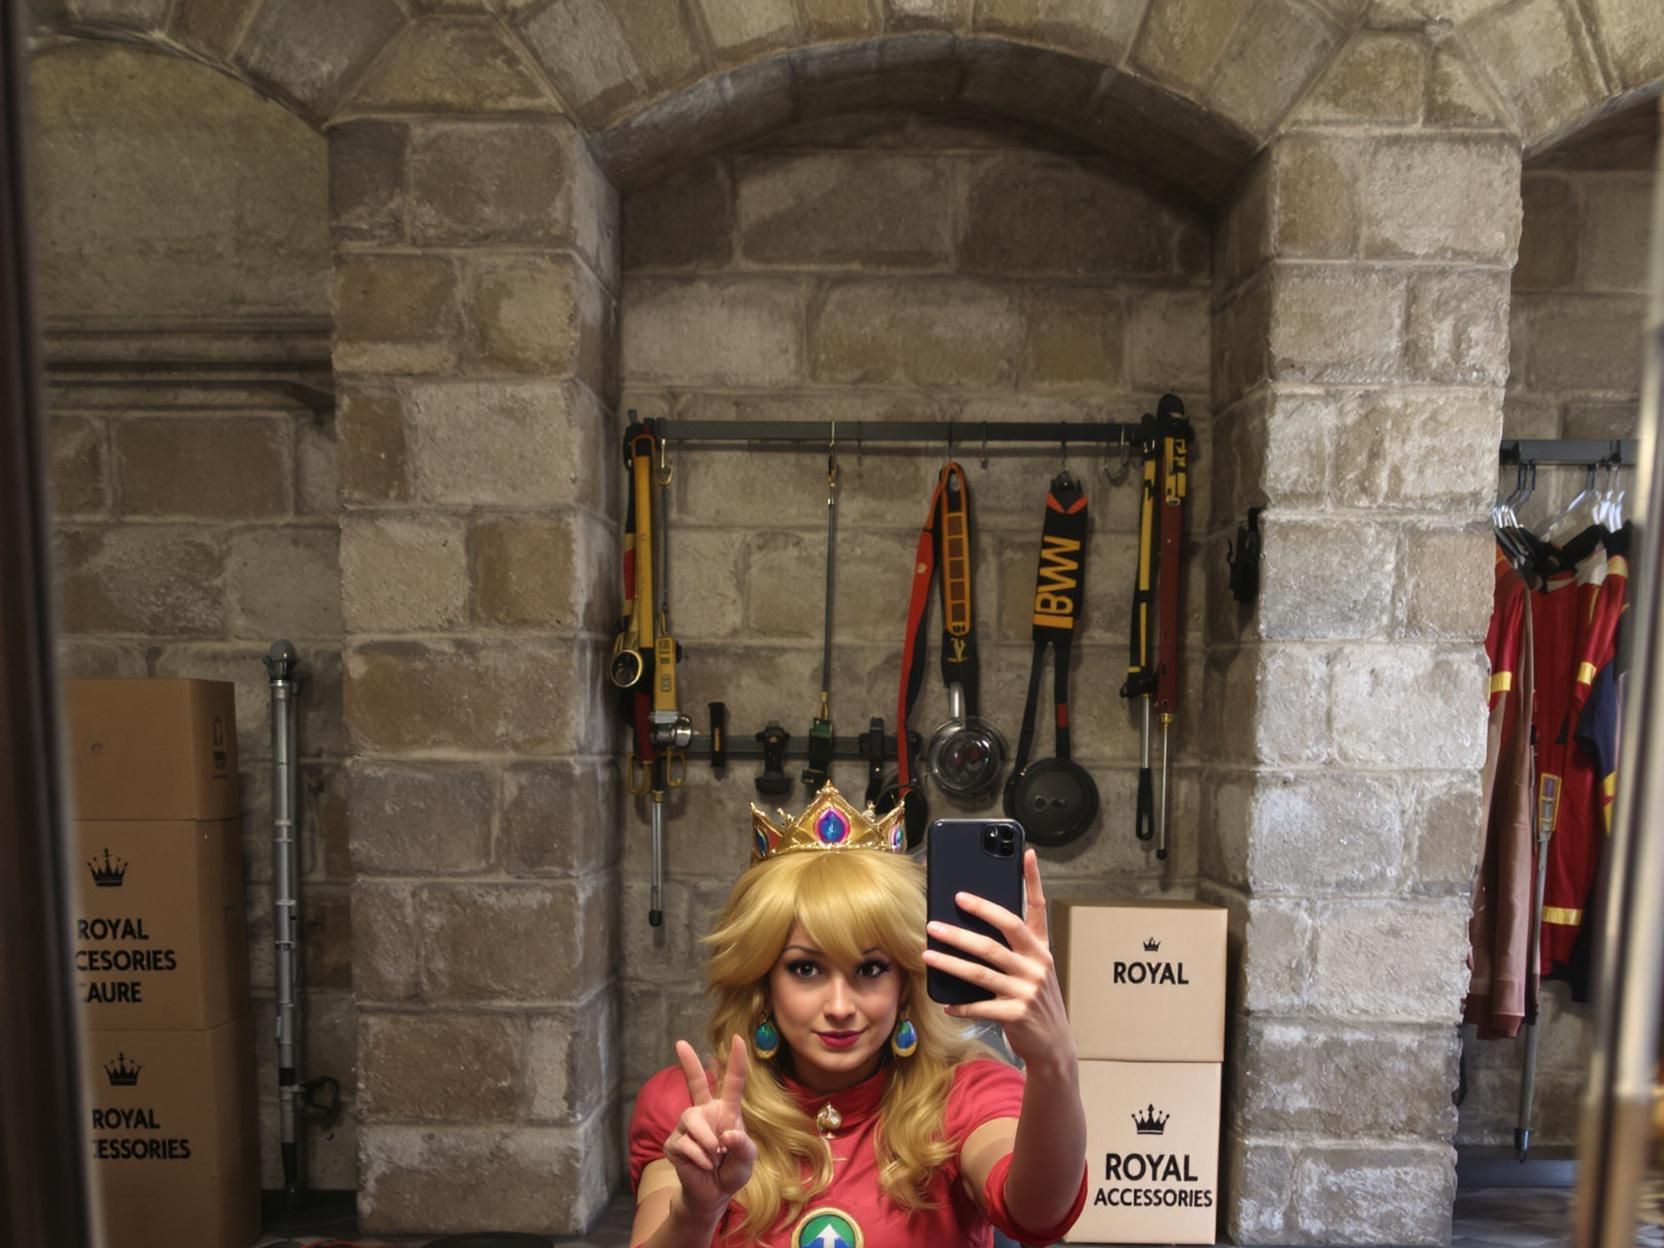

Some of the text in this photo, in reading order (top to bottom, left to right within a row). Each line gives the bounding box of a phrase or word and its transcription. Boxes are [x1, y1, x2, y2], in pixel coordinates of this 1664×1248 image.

[77, 918, 150, 940] ROYAL
[1113, 962, 1189, 984] ROYAL
[79, 981, 142, 1003] AURE
[92, 1108, 161, 1129] ROYAL
[1105, 1154, 1198, 1182] ROYAL
[1094, 1188, 1213, 1208] ACCESSORIES
